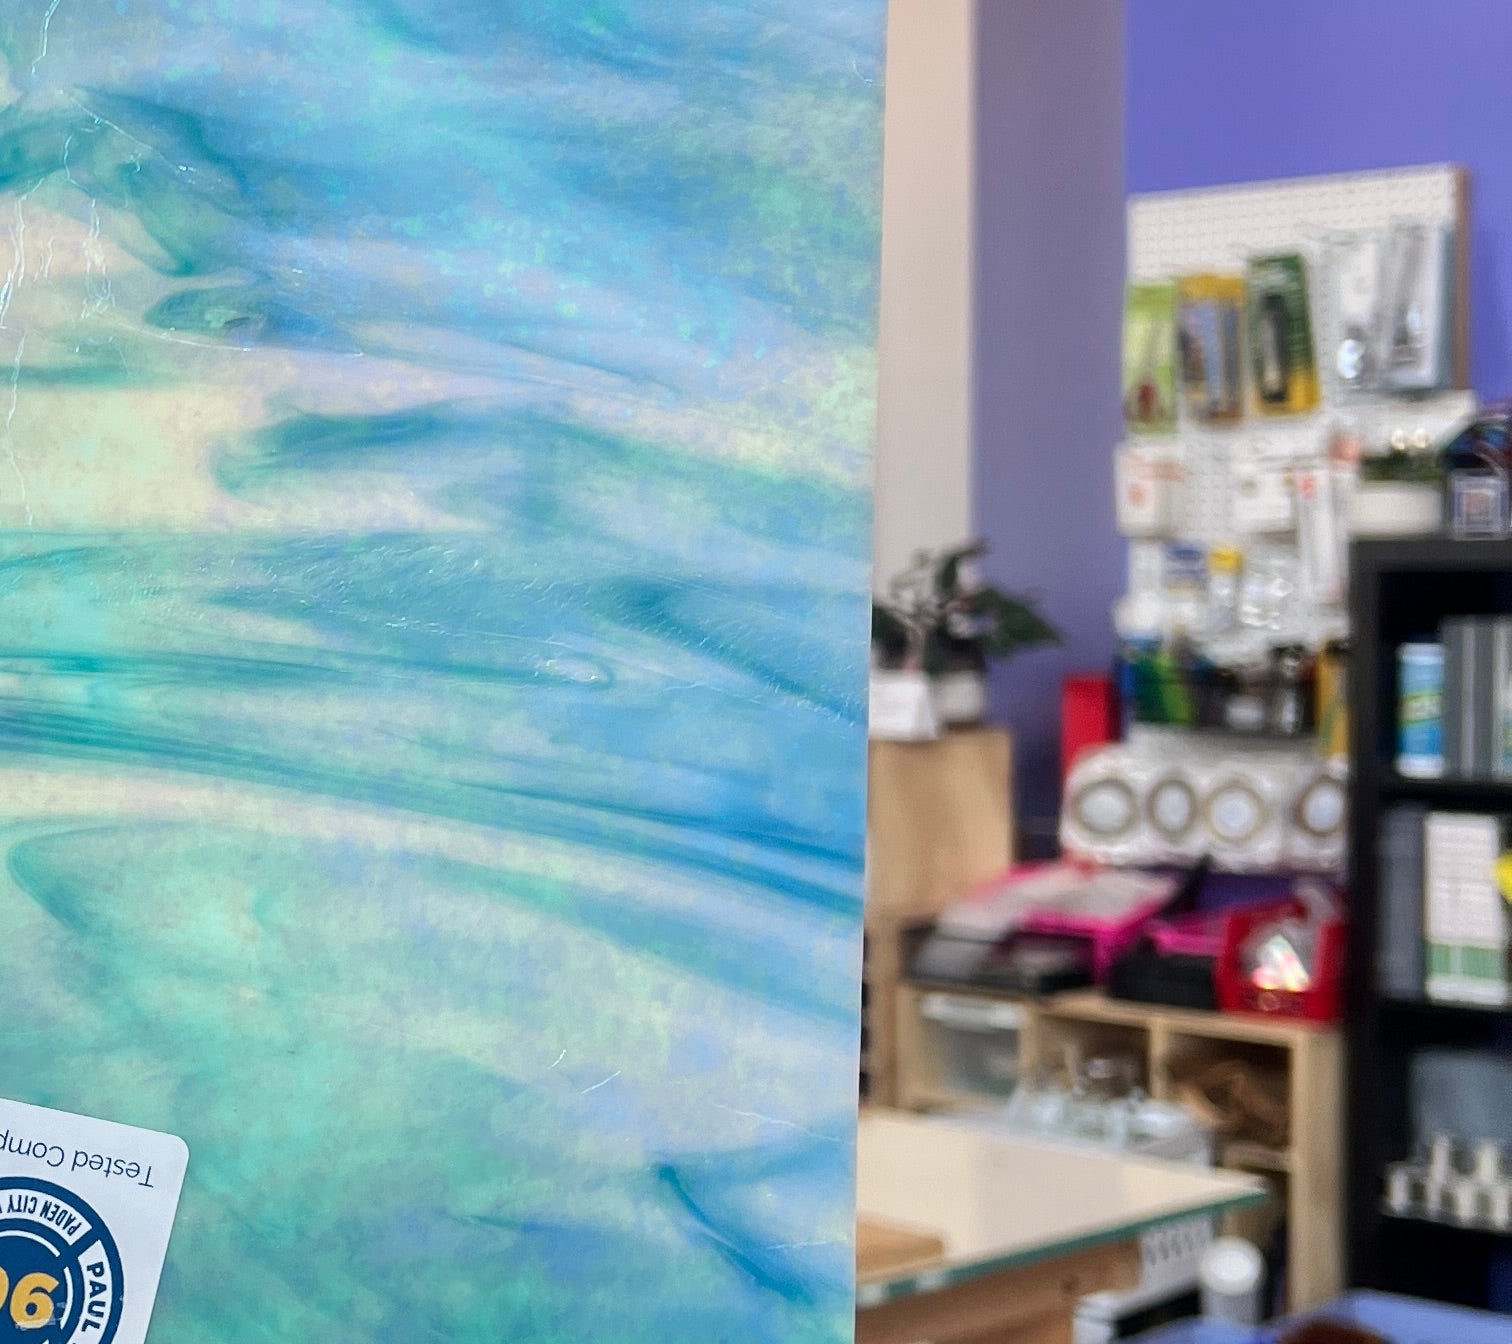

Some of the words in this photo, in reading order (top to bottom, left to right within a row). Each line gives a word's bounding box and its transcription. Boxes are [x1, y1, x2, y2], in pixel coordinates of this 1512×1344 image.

[71, 1150, 154, 1188] Tested
[7, 1195, 37, 1214] CITY
[39, 1198, 82, 1236] PADEN
[81, 1261, 107, 1332] PAUL
